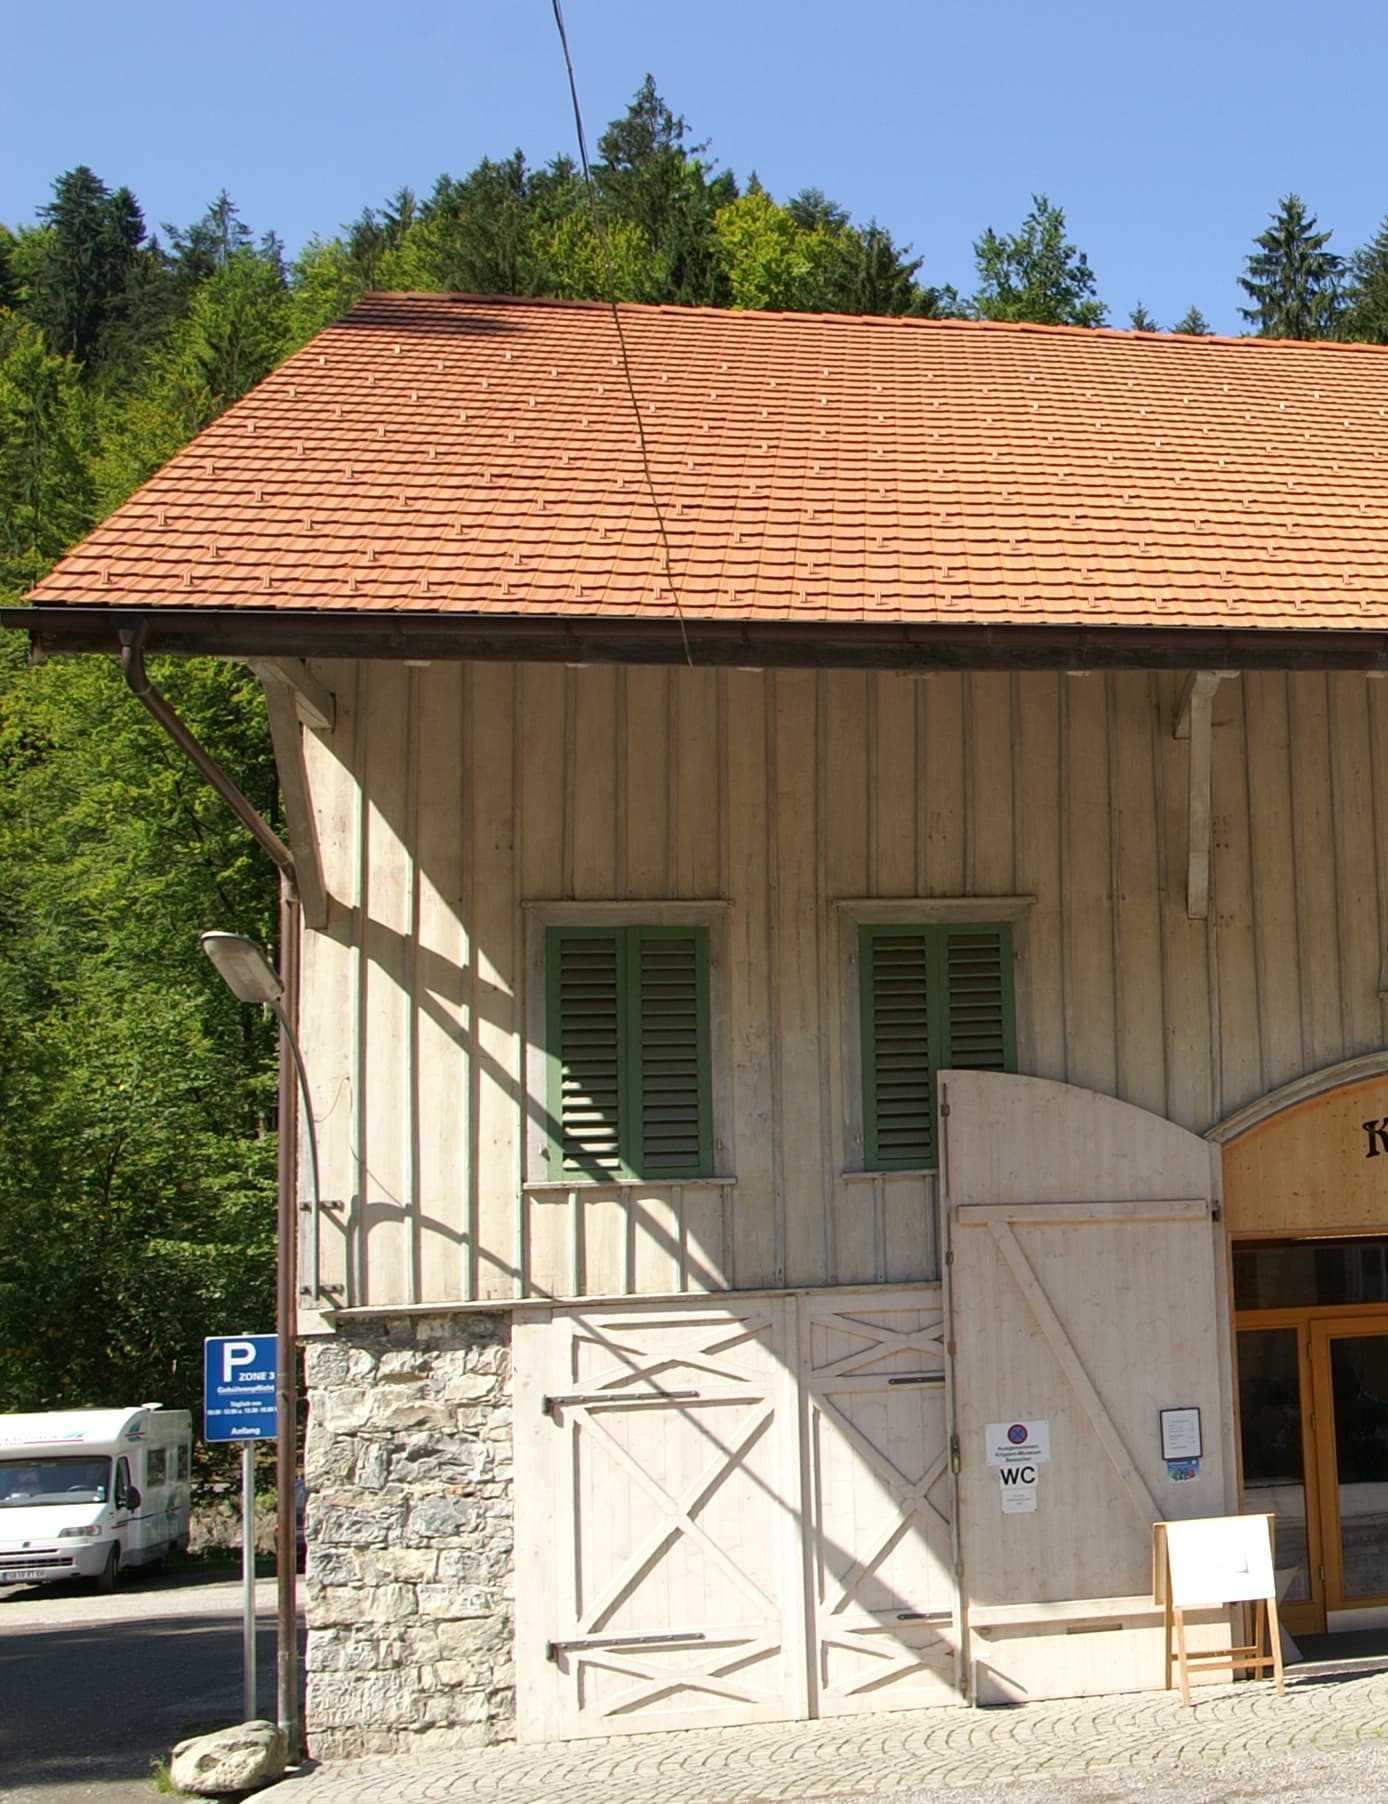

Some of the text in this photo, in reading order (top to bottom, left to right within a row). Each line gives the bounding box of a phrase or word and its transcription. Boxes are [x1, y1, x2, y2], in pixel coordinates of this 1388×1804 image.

[223, 1341, 257, 1383] P
[239, 1371, 276, 1382] ZONE 3
[999, 1466, 1036, 1486] WC
